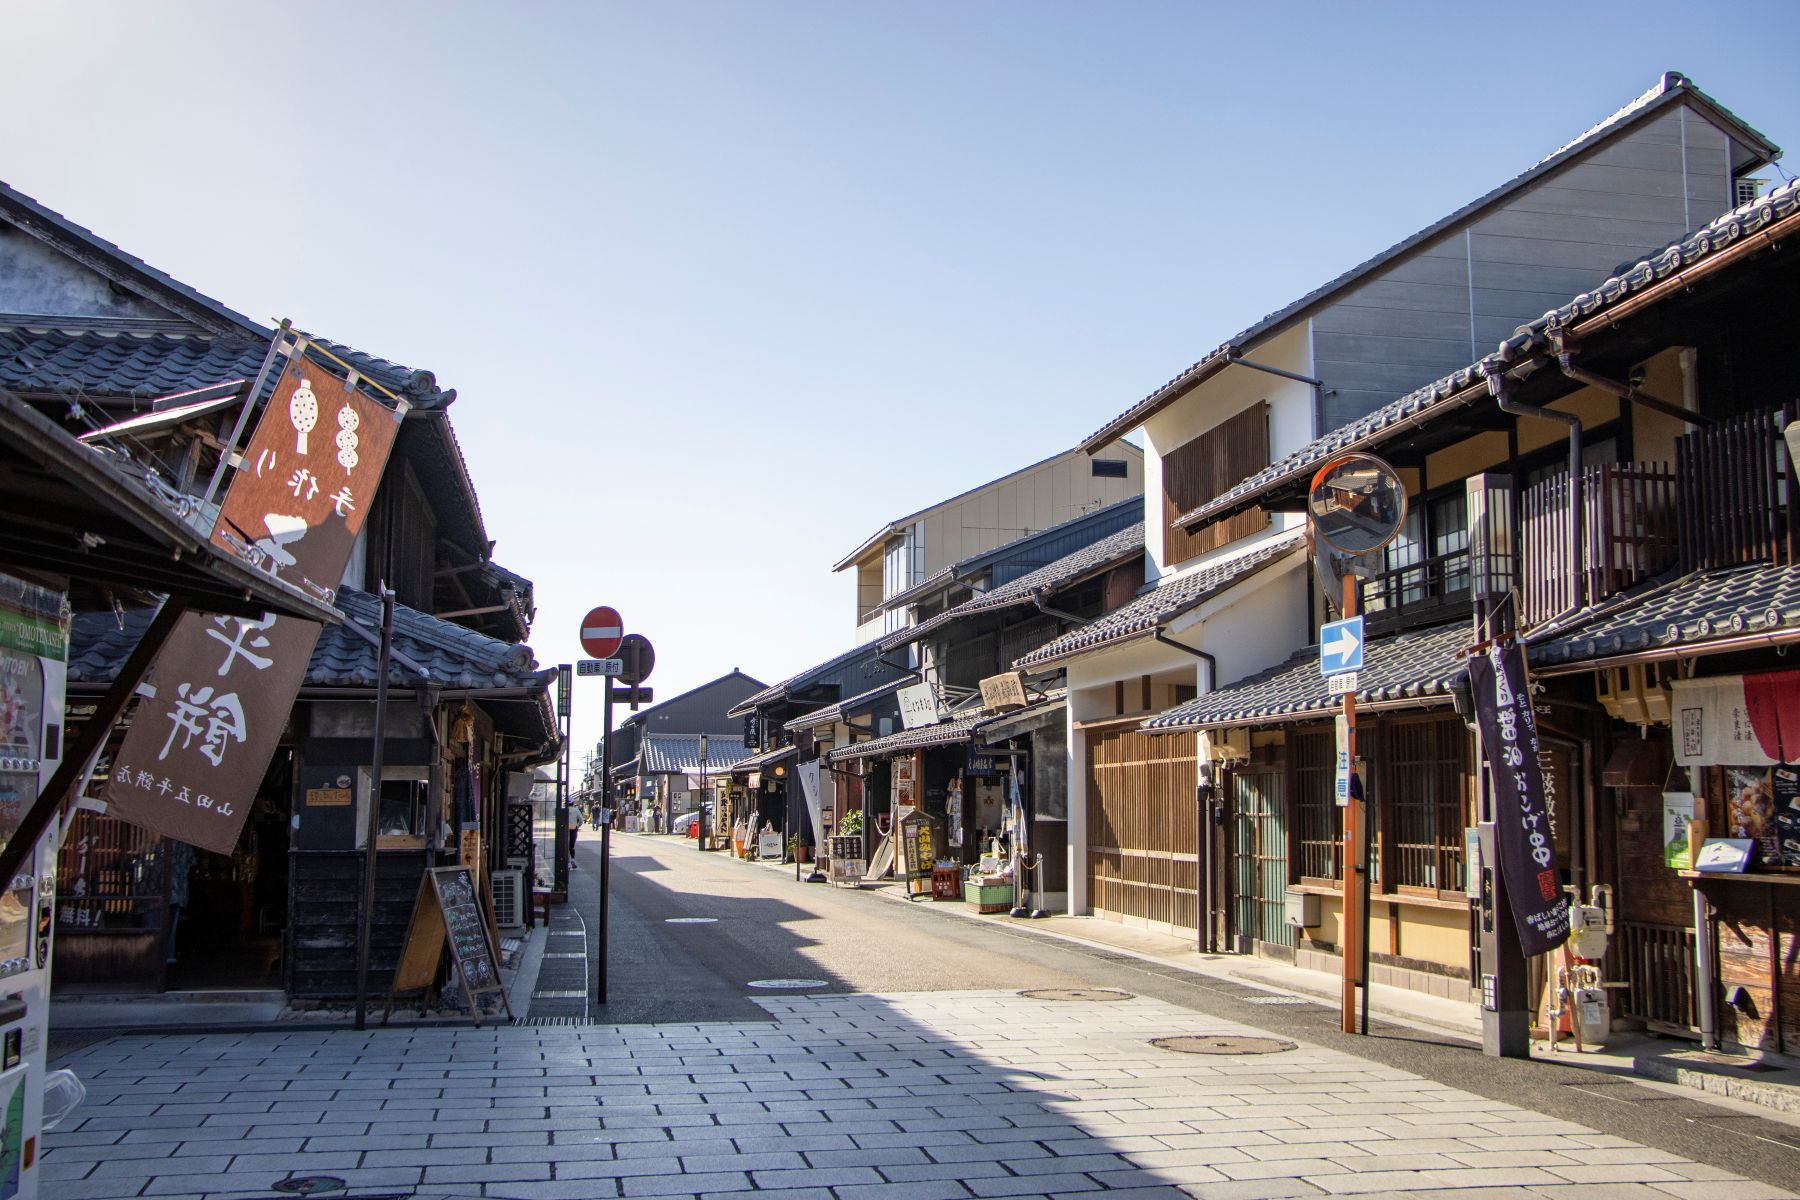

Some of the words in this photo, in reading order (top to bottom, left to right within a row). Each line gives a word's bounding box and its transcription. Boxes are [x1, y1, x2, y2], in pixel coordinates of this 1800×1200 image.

[579, 661, 620, 674] 自動車・原付
